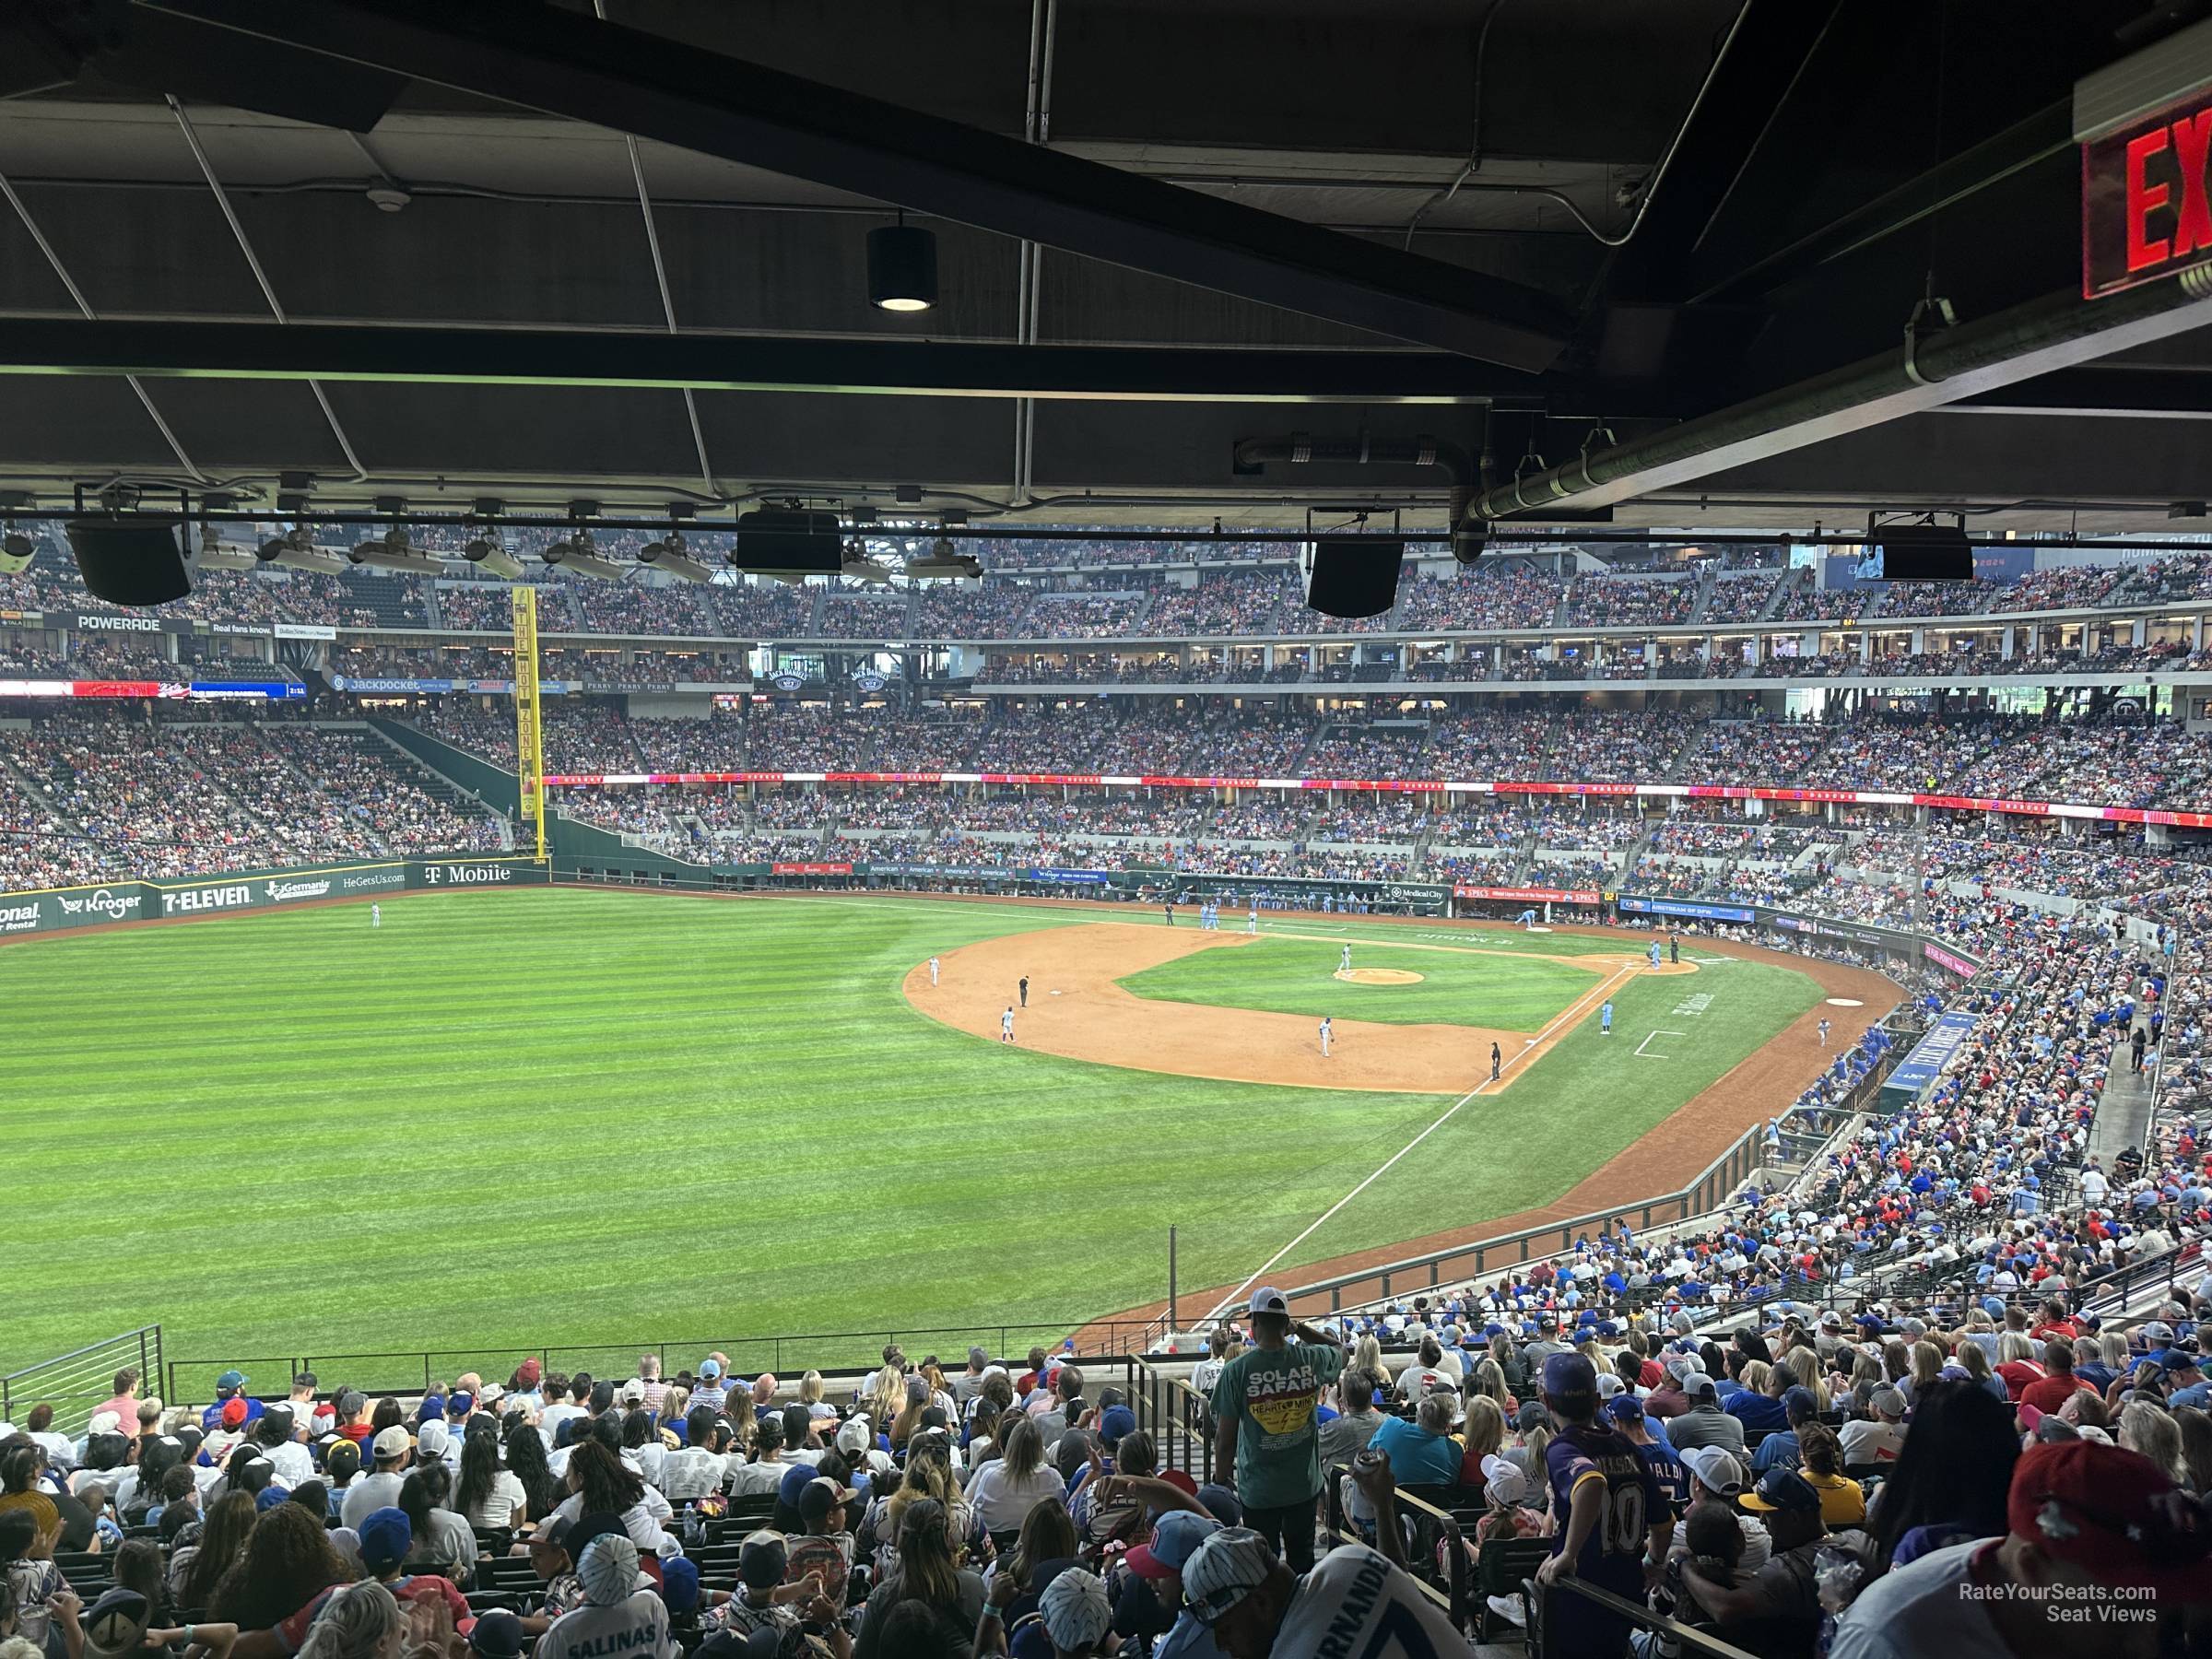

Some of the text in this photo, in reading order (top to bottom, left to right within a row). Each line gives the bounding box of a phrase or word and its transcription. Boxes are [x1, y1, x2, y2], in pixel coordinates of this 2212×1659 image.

[78, 616, 160, 631] POWERADE
[213, 624, 271, 634] Real fans know.
[518, 613, 526, 651] THE
[520, 662, 528, 698] HOT
[522, 711, 531, 759] ZONE
[343, 874, 406, 888] HeGetsUs.com
[449, 865, 511, 882] Mobile
[283, 879, 332, 893] Germania
[1402, 889, 1443, 900] Medical City
[86, 889, 141, 919] Kroger
[6, 920, 37, 931] Rental
[1249, 1365, 1312, 1384] SOLAR
[1252, 1402, 1283, 1414] HEART
[1601, 1481, 1647, 1557] 10
[568, 1624, 656, 1659] SALINAS
